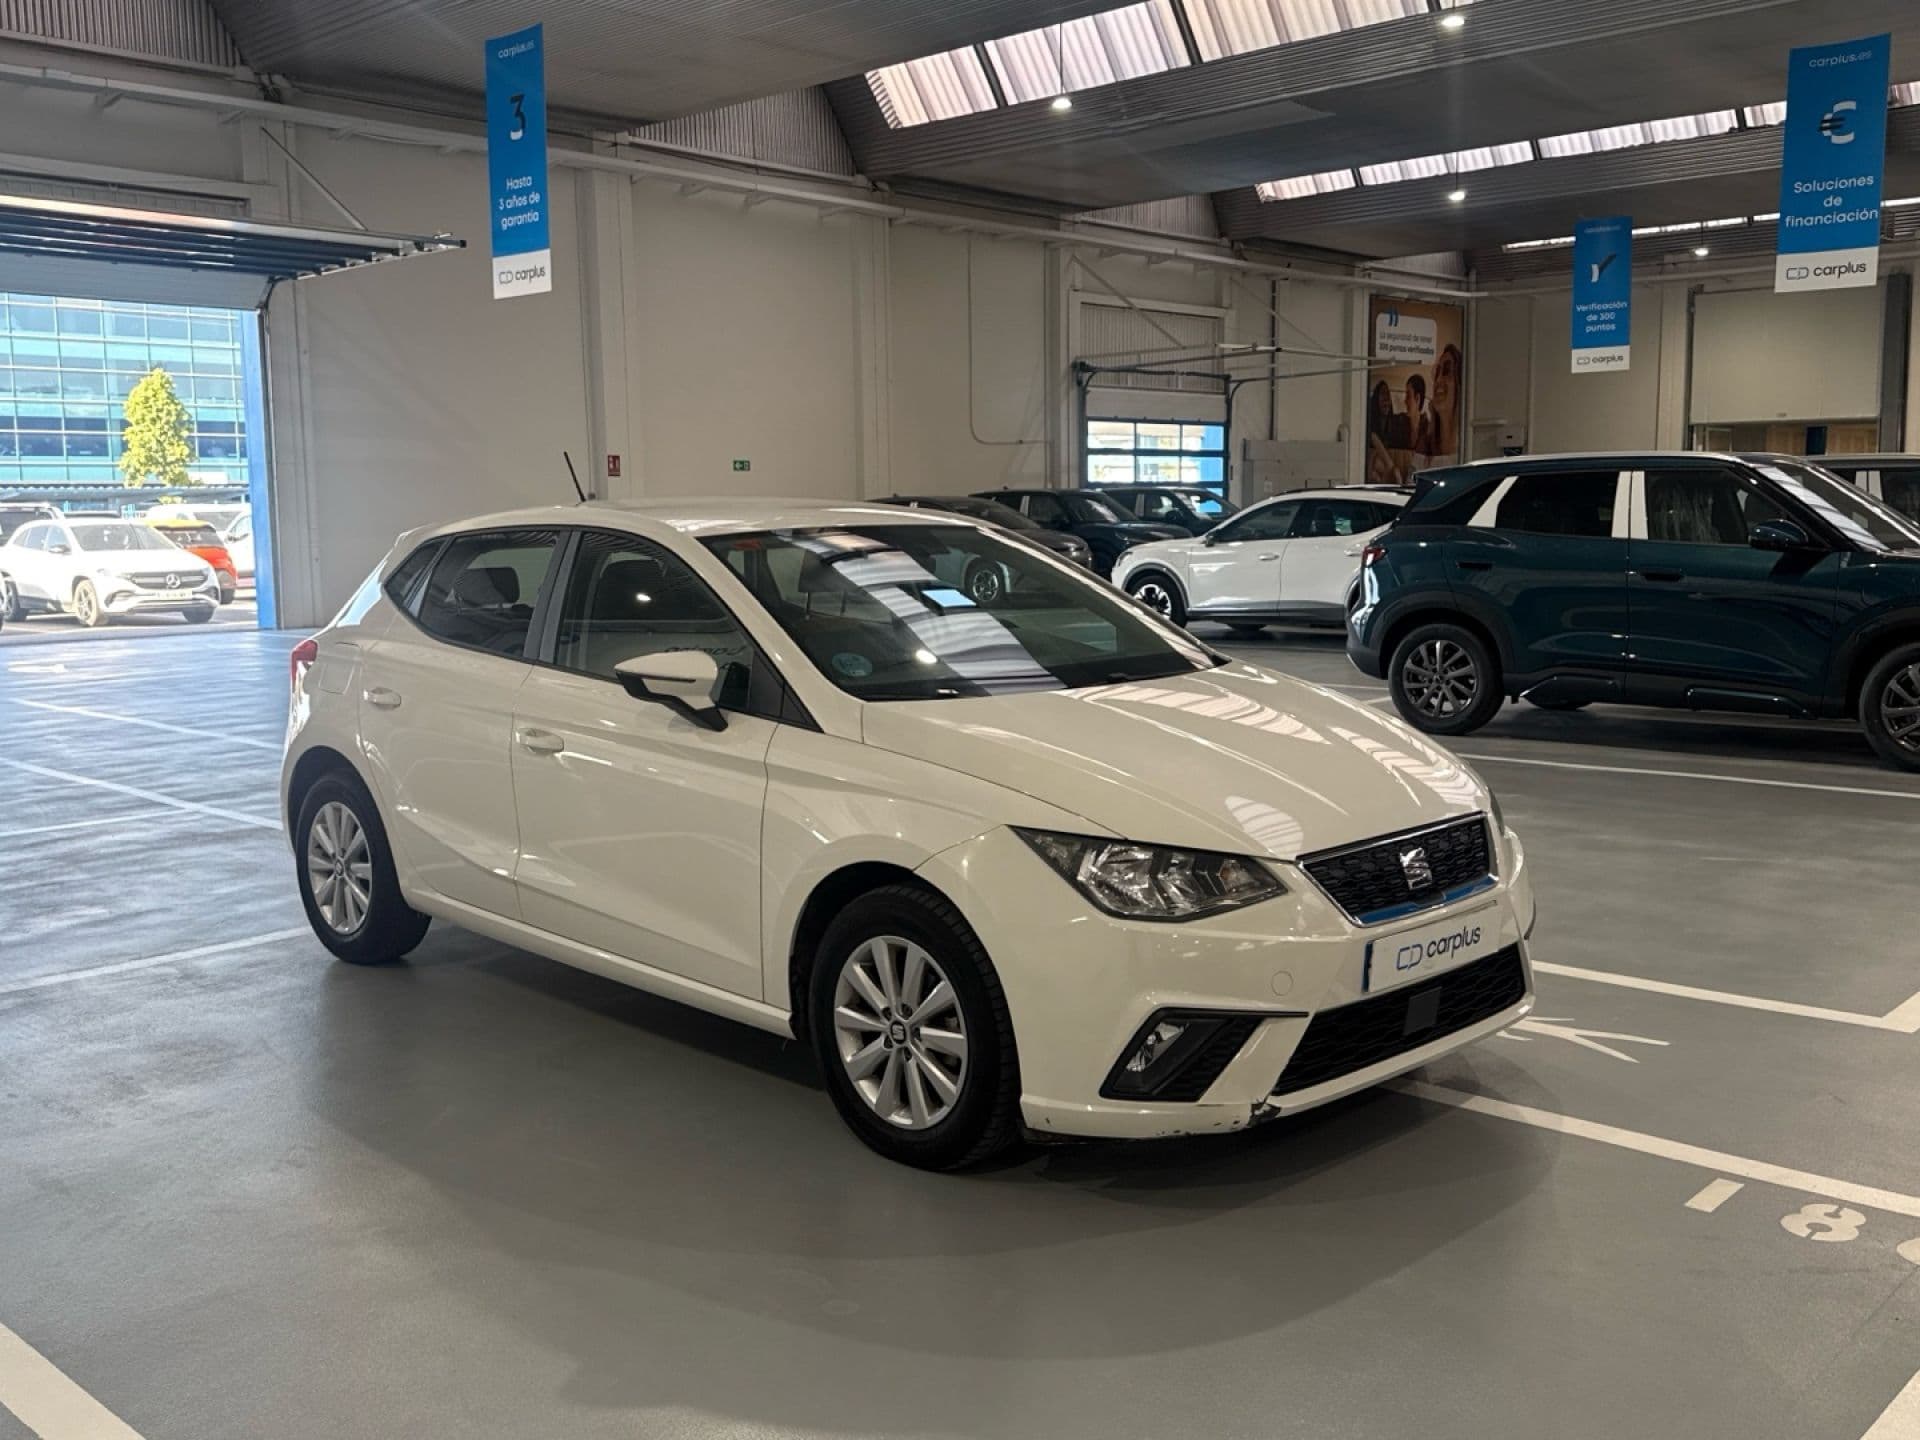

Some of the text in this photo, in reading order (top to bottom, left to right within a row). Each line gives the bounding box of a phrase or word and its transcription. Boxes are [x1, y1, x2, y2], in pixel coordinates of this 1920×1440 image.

[1809, 51, 1873, 68] carplus.es
[509, 94, 526, 141] 3
[506, 174, 533, 191] Hasta
[1793, 174, 1875, 194] Soluciones
[498, 191, 541, 210] 3 años de
[1823, 194, 1843, 208] de
[501, 211, 540, 231] garantía
[1785, 206, 1879, 228] financiación
[515, 264, 546, 284] carplus
[1813, 260, 1867, 280] carplus
[1576, 300, 1628, 313] Verificación
[1585, 312, 1616, 322] de 300
[1585, 322, 1617, 334] puntos
[1591, 354, 1624, 367] carplus
[1426, 925, 1481, 959] carplus
